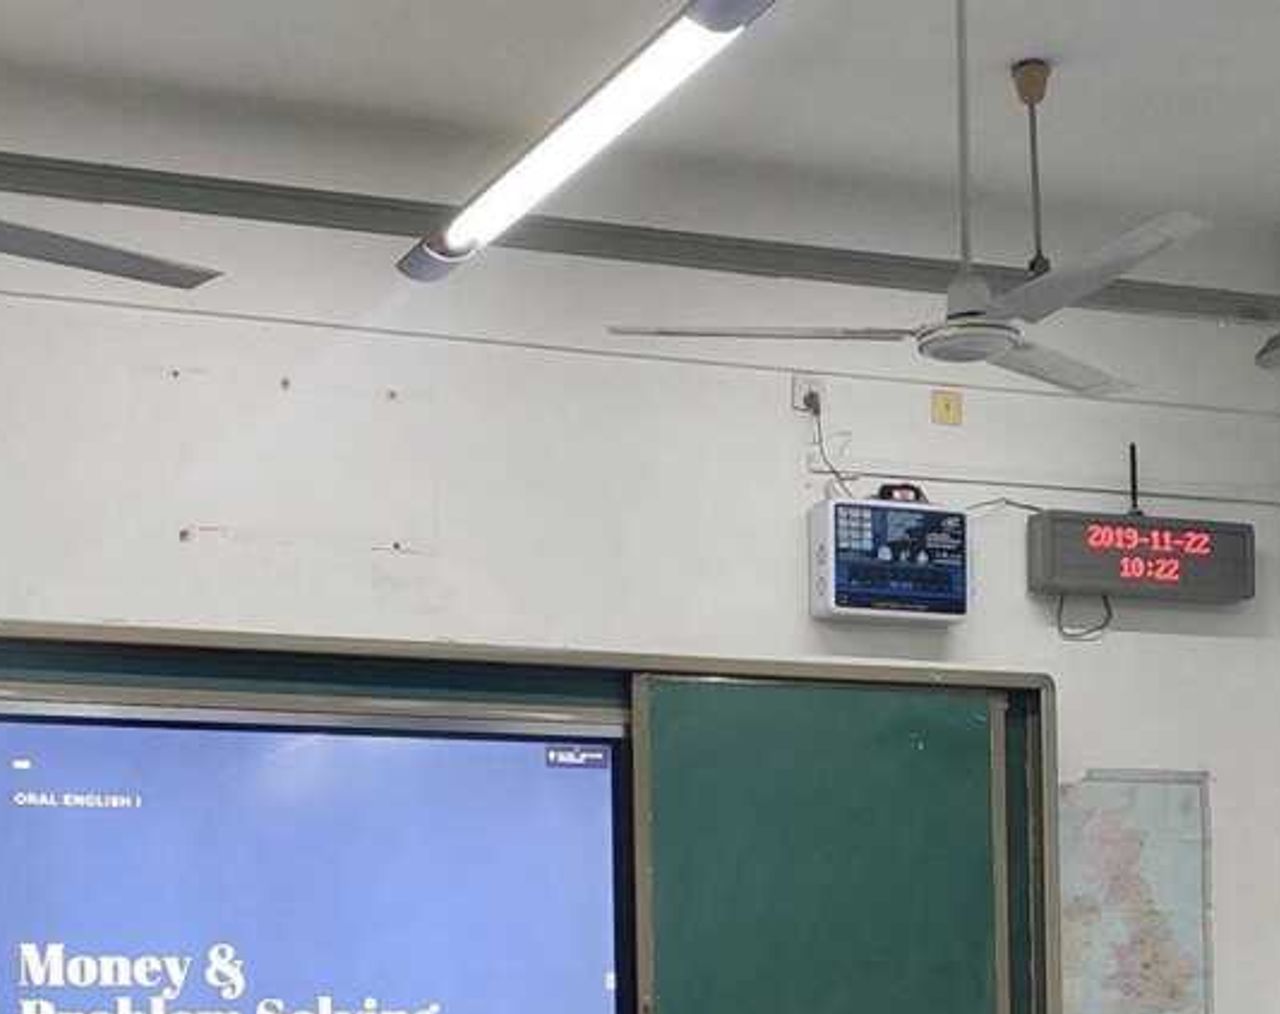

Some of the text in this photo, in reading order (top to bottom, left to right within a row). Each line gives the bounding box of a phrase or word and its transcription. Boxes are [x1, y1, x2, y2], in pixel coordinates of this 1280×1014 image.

[1088, 525, 1210, 554] 2019-11-22
[1120, 556, 1179, 580] 10:22
[14, 792, 58, 806] ORAL
[64, 793, 131, 807] ENGLISH
[18, 943, 246, 998] Money &
